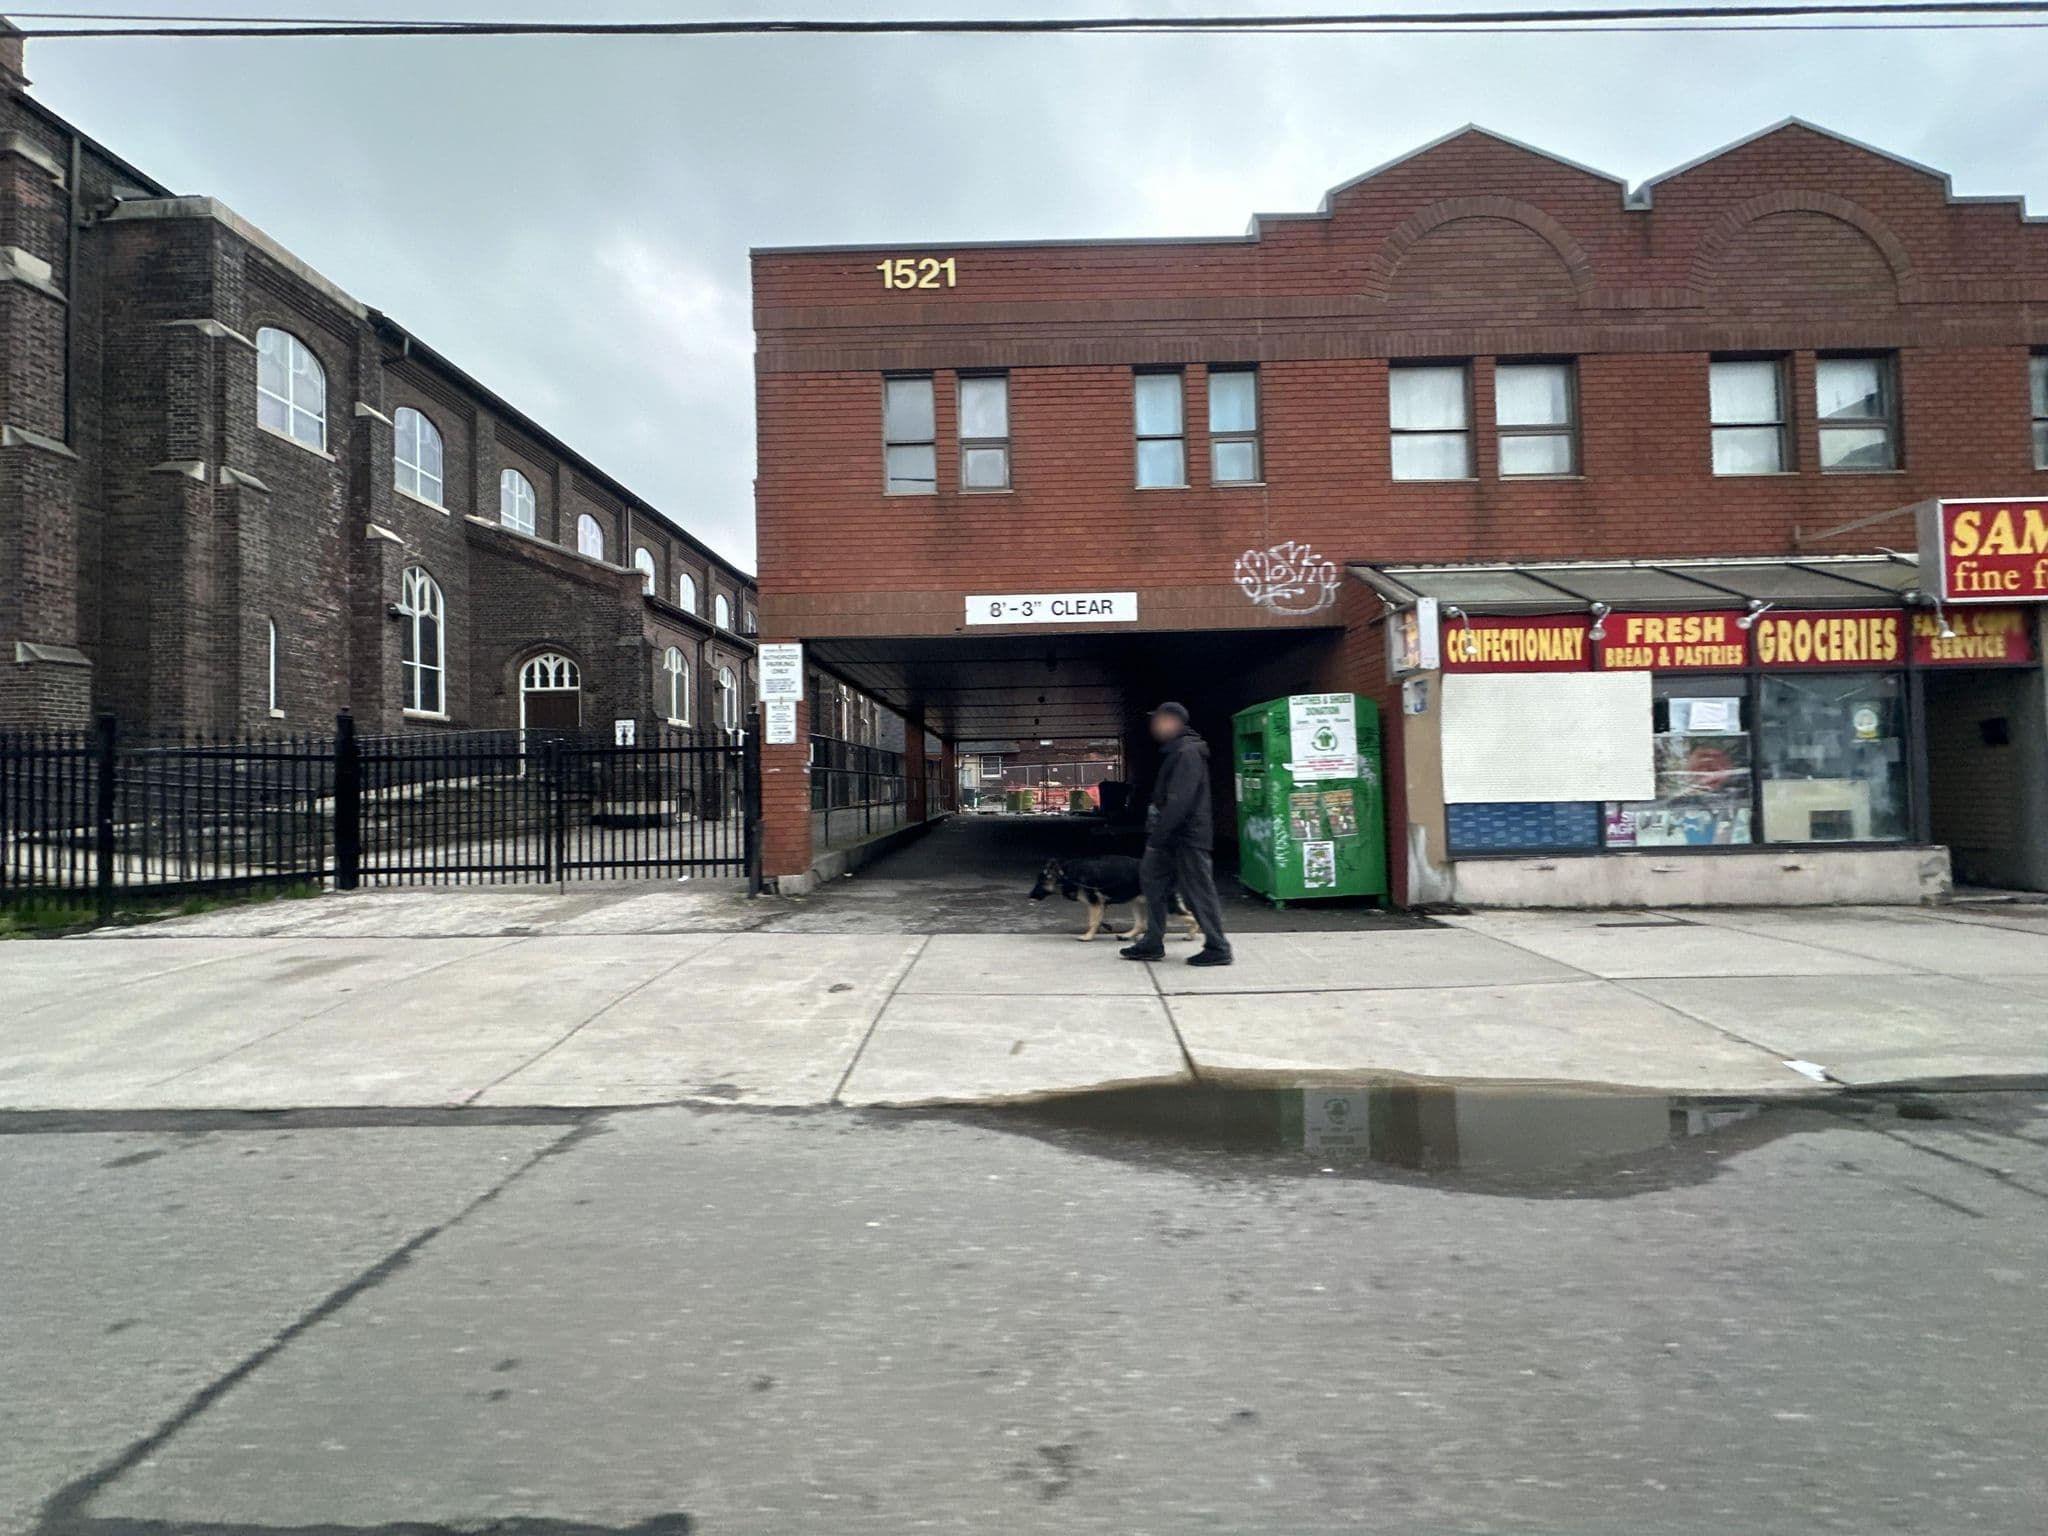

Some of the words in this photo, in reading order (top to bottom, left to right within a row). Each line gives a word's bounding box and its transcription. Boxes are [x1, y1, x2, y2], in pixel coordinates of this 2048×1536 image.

[876, 257, 956, 289] 1521
[1953, 560, 2022, 592] fine
[1051, 600, 1113, 616] CLEAR
[1447, 627, 1585, 663] CONFECTIONARY
[1626, 616, 1726, 644] FRESH
[1757, 617, 1898, 663] GROCERIES
[1605, 646, 1653, 667] BREAD
[1658, 646, 1671, 667] &
[1675, 644, 1743, 666] PASTRIES
[1931, 636, 2006, 660] SERVICE
